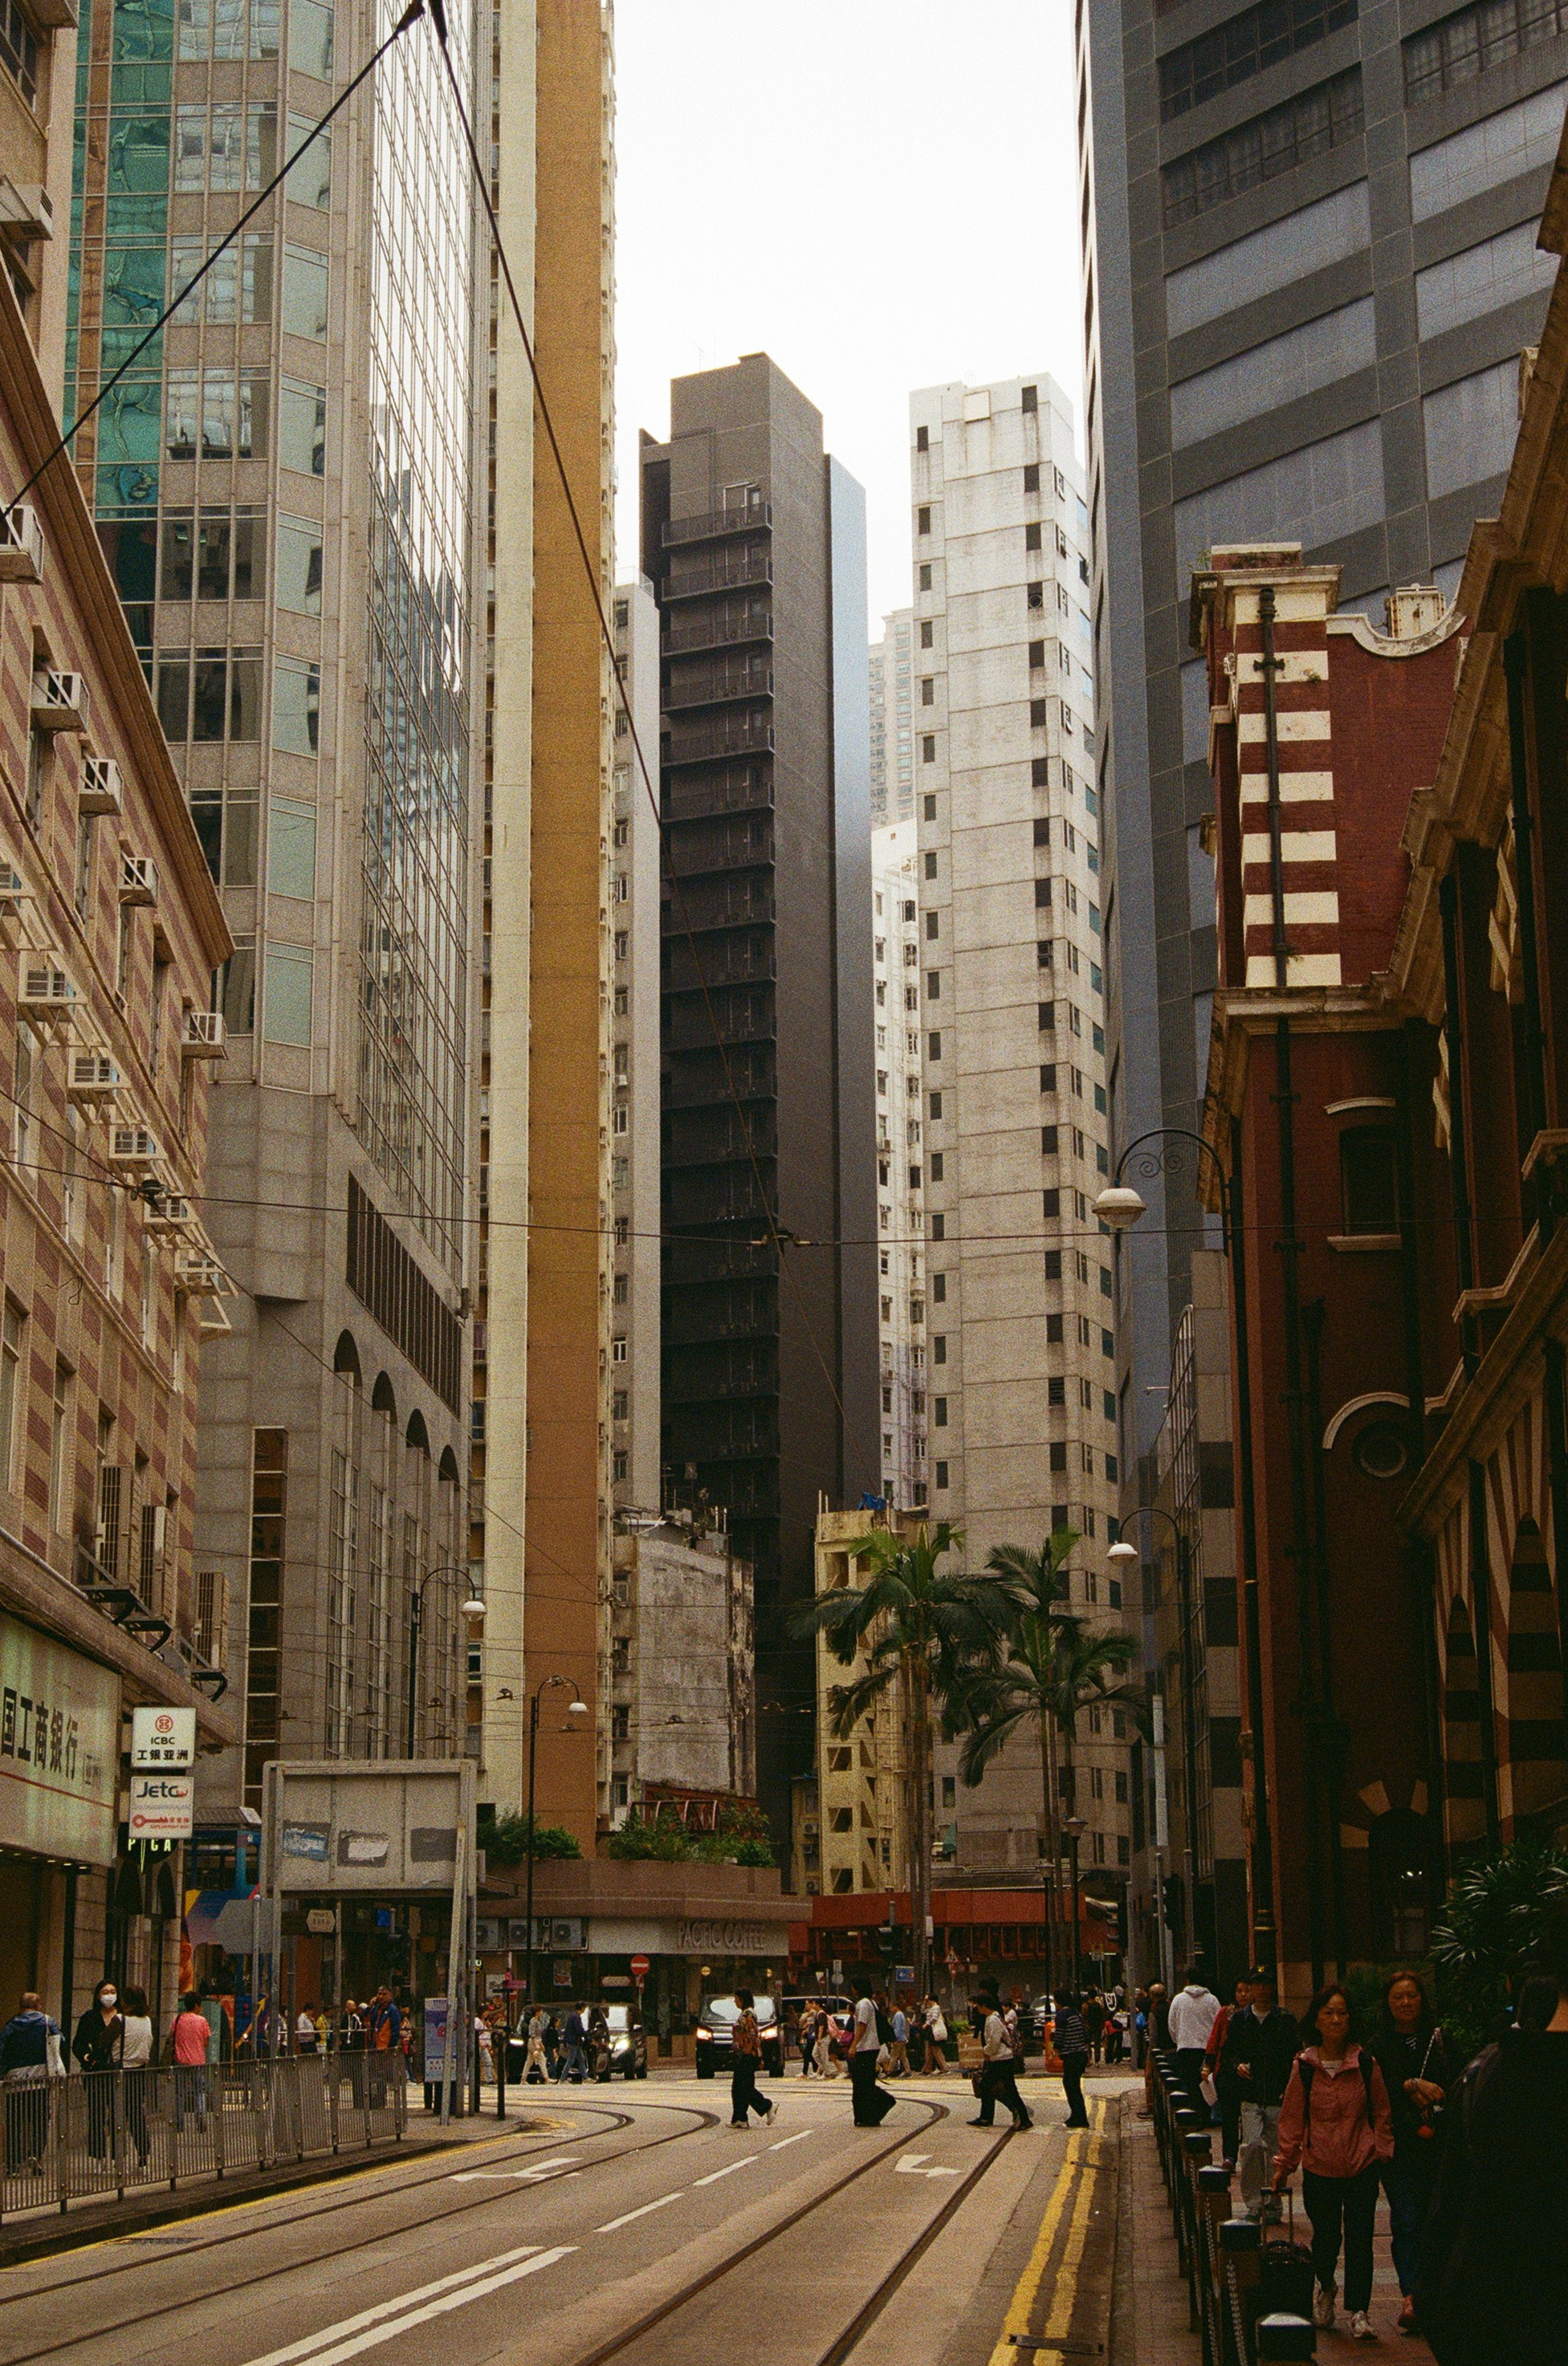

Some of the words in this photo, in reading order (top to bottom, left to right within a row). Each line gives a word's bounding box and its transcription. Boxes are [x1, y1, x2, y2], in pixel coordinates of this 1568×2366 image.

[150, 1737, 176, 1745] ICBC
[136, 1749, 189, 1761] 工银亚洲
[678, 1920, 723, 1949] PACIFIC
[723, 1922, 765, 1950] COFFEE
